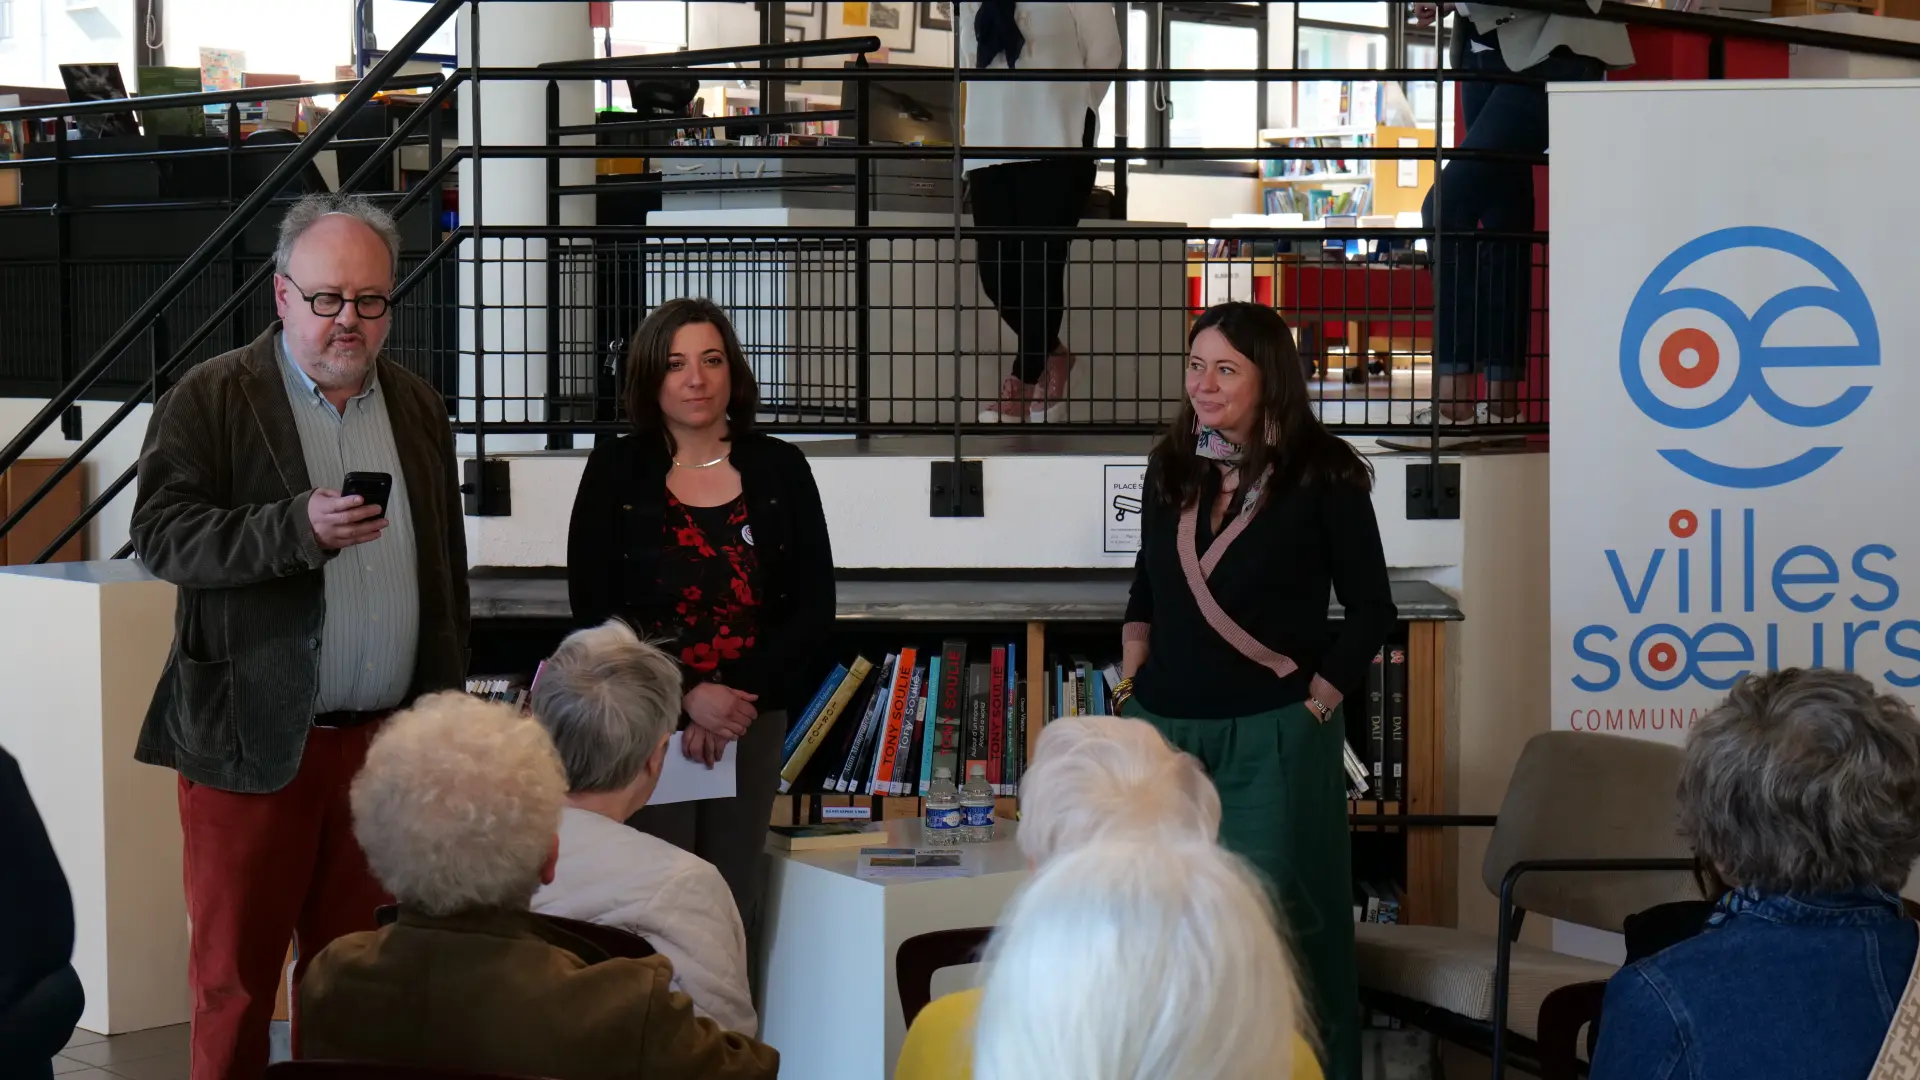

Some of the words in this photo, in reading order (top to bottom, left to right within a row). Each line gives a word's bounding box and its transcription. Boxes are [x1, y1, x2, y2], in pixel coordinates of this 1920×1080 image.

[1604, 508, 1900, 614] villes
[1571, 619, 1920, 692] sœurs
[899, 720, 914, 750] Tony
[940, 714, 954, 756] TONY
[991, 722, 1001, 759] TONY
[1570, 708, 1708, 732] COMMUNA
[884, 724, 899, 765] TONY
